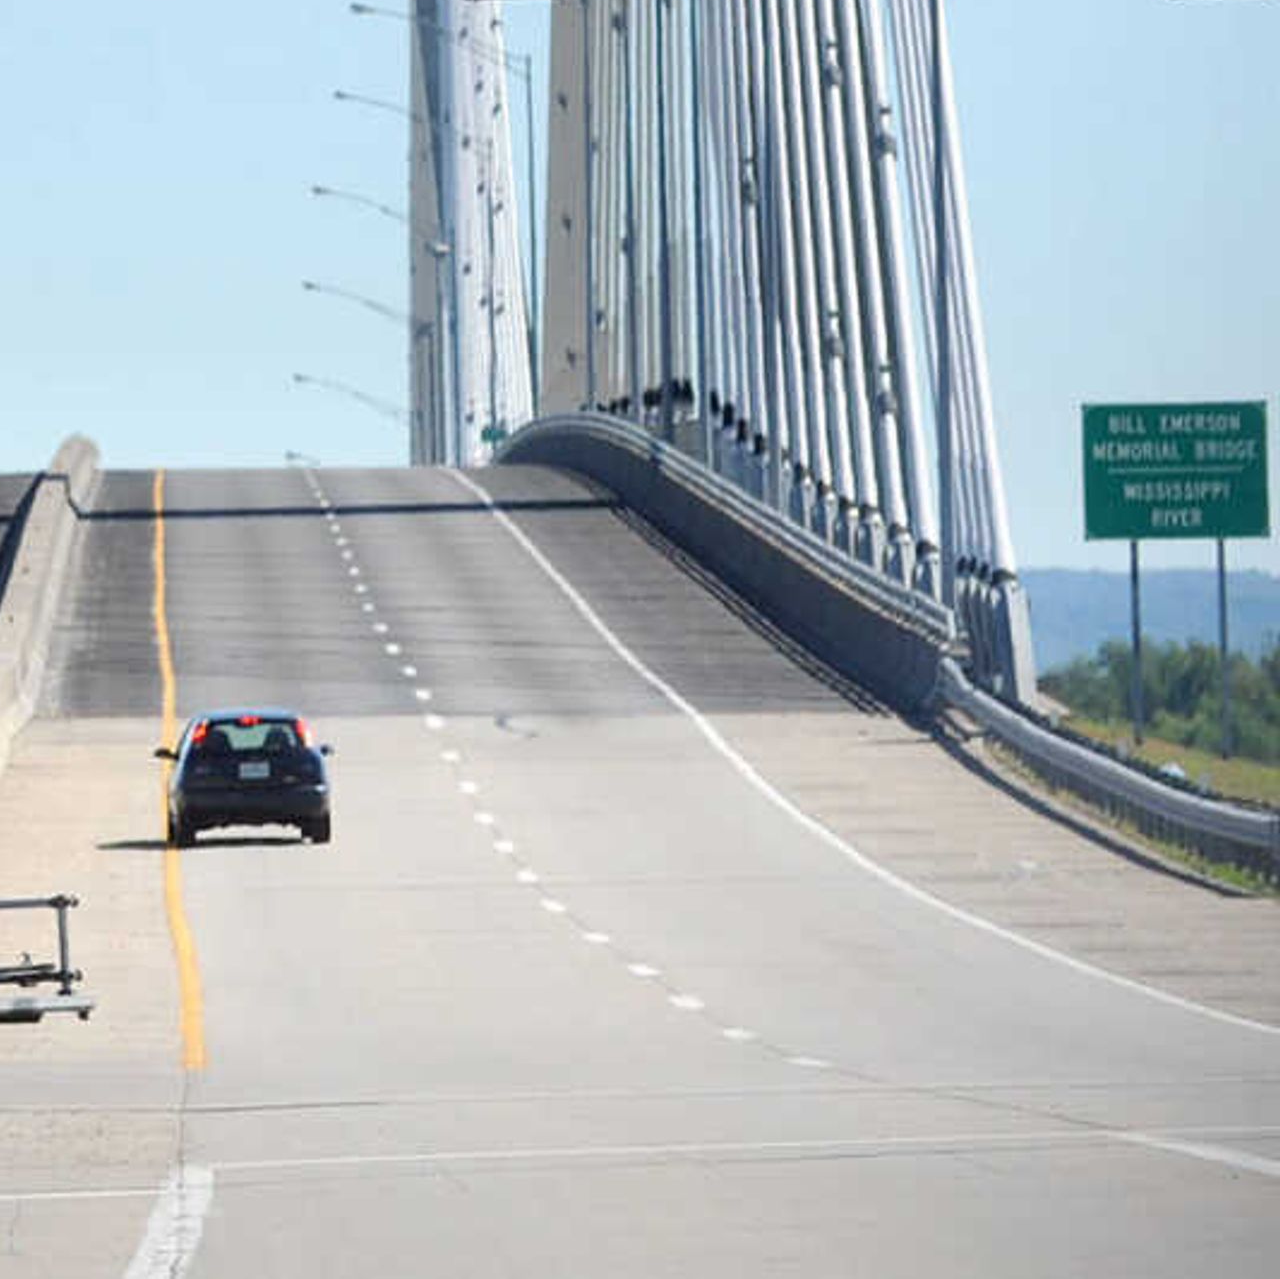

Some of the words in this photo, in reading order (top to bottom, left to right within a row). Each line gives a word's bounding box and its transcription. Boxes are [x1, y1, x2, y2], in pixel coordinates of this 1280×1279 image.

[1109, 413, 1147, 434] BILL
[1160, 411, 1241, 434] EMERSON
[1093, 440, 1180, 462] MEMORIAL
[1196, 439, 1258, 462] BRIDGE
[1124, 481, 1231, 501] MISSISSIPPI
[1151, 508, 1203, 527] RIVER
